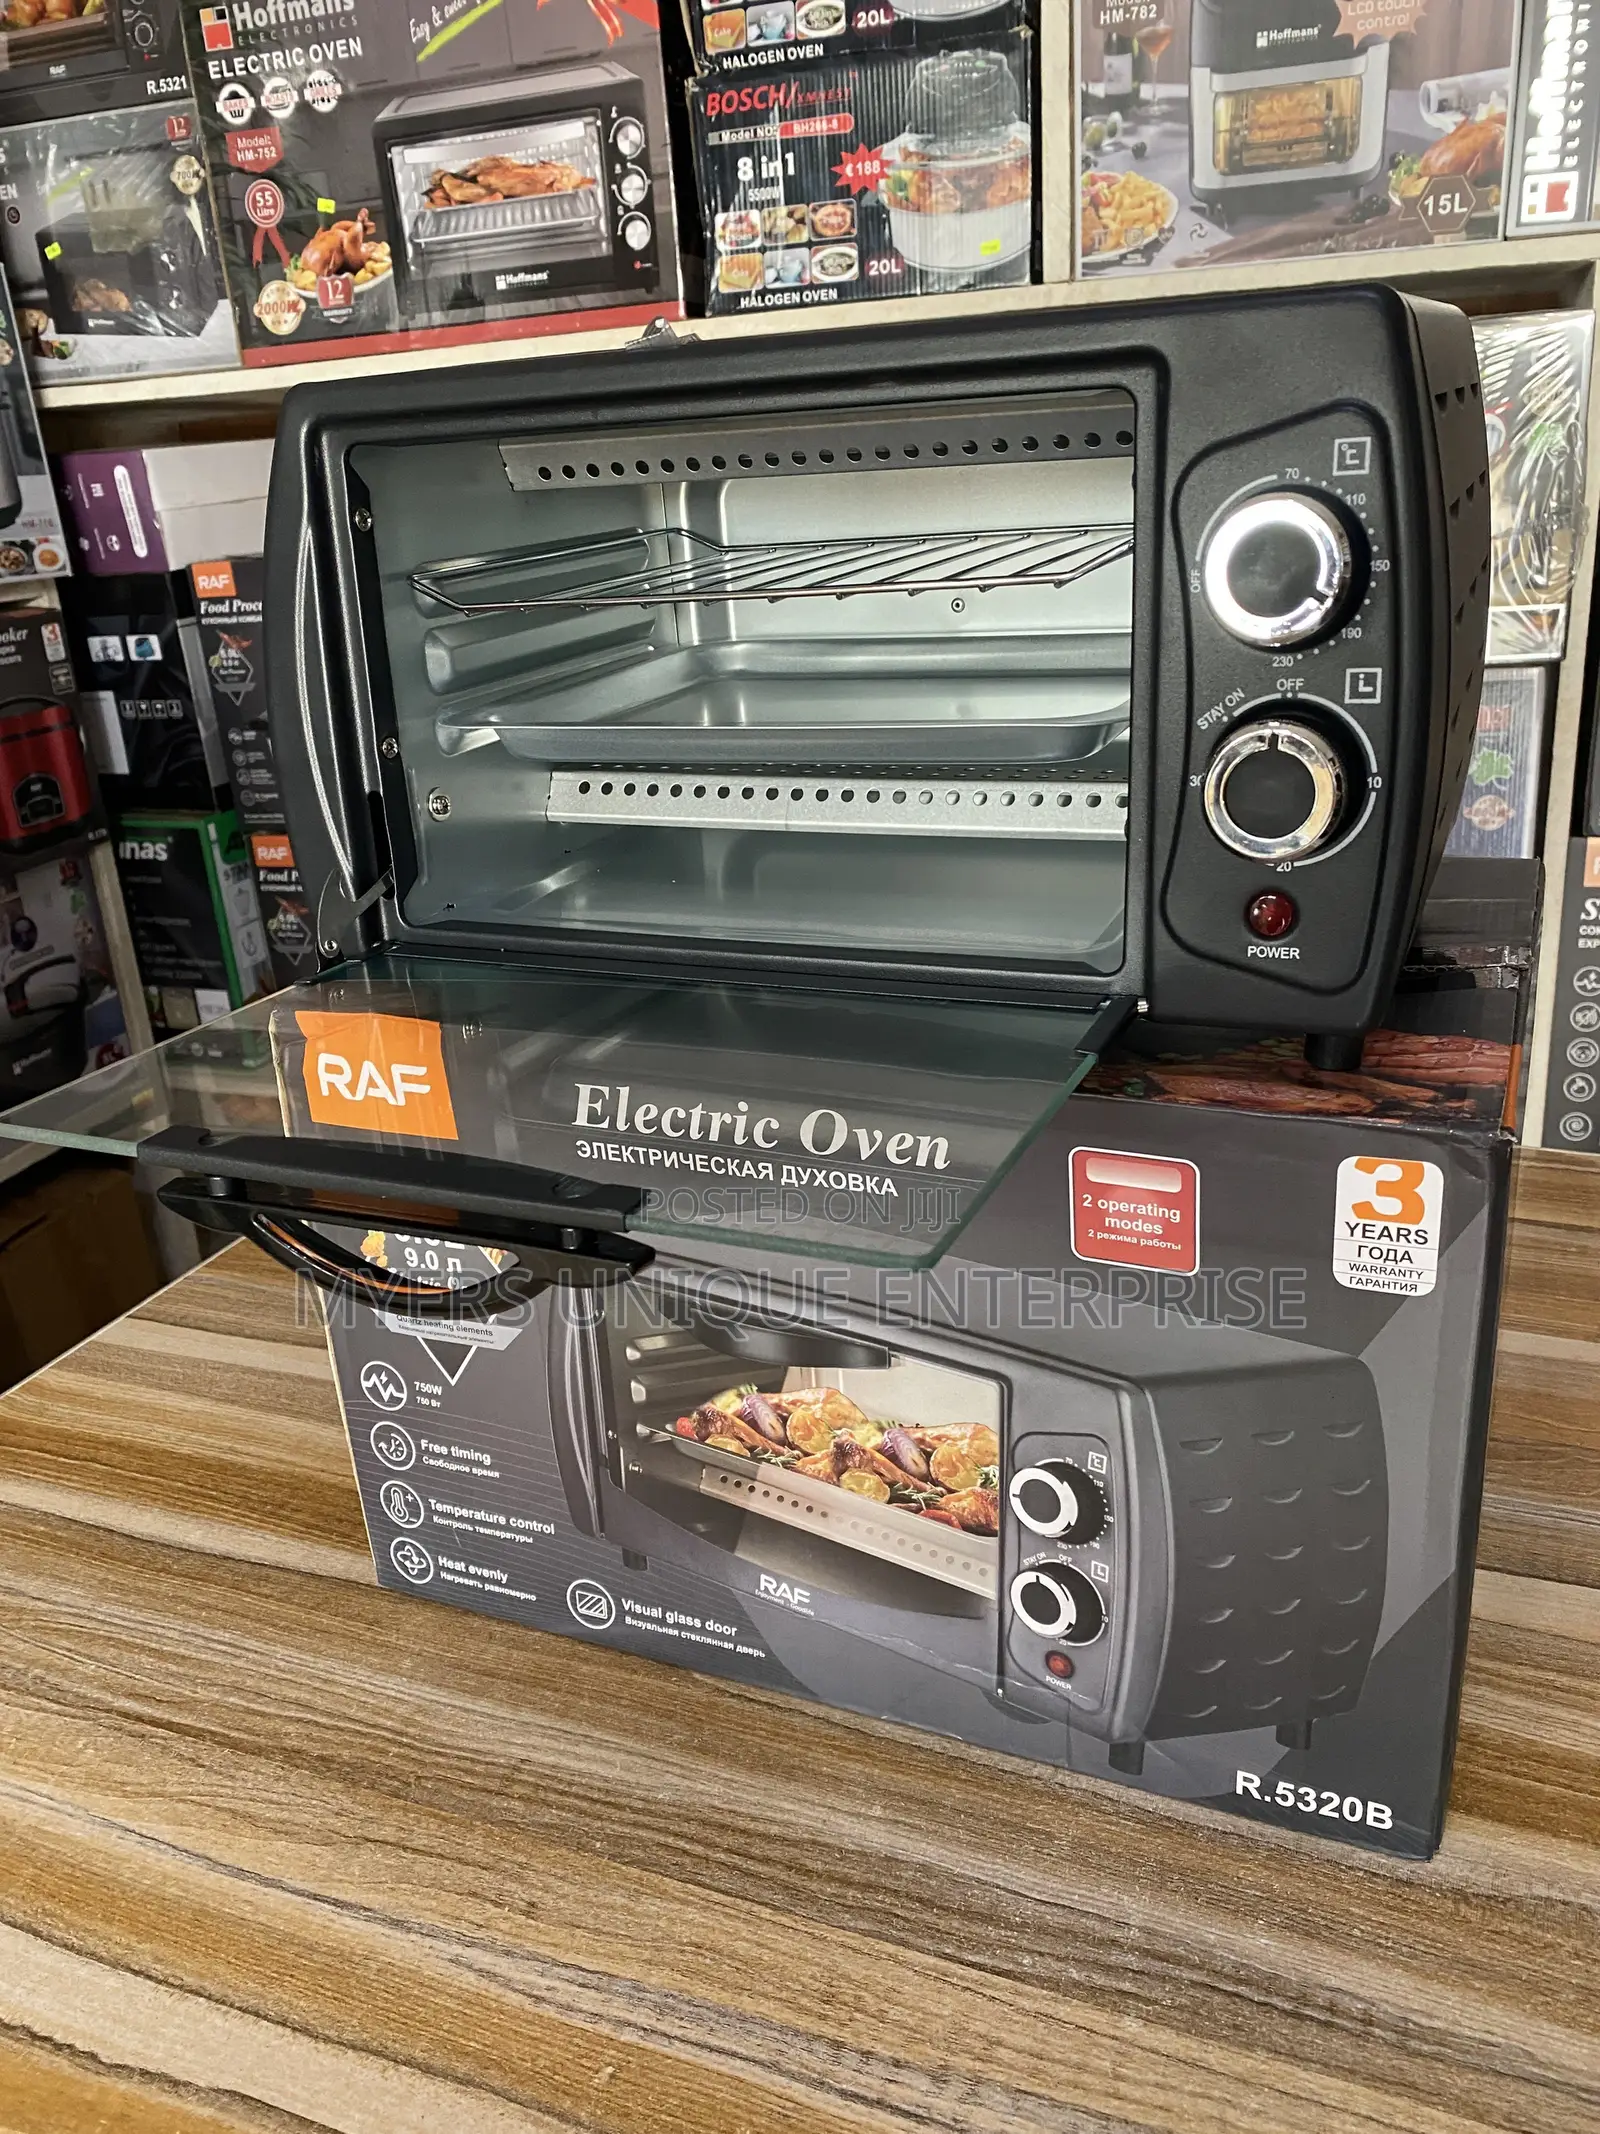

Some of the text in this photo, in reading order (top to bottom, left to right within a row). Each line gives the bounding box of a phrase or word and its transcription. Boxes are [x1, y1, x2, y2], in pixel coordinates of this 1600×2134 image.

[232, 0, 355, 31] Hoffmans
[856, 6, 890, 28] 20L
[1100, 4, 1157, 25] HM-782
[1356, 13, 1410, 30] control
[238, 15, 358, 46] ELECTRONICS
[409, 18, 431, 44] Easy
[1269, 27, 1319, 41] Hoffmans
[208, 36, 363, 79] ELECTRIC OVEN
[723, 43, 824, 70] HALOGEN OVEN
[147, 75, 187, 95] R.5321
[236, 135, 272, 149] Model:
[722, 128, 754, 142] Model
[236, 147, 277, 162] HM-752
[737, 151, 795, 182] 8 in 1
[255, 190, 273, 207] 55
[1422, 192, 1468, 217] 15L
[256, 206, 275, 218] Litre
[868, 258, 901, 276] 20L
[326, 280, 345, 300] 12
[740, 288, 838, 309] HALOGEN OVEN
[1285, 468, 1300, 480] 70
[1345, 493, 1367, 506] 110
[1370, 560, 1391, 572] 150
[198, 574, 230, 590] RAF
[1190, 569, 1202, 594] OFF
[200, 600, 230, 615] Food
[1341, 627, 1362, 640] 190
[1272, 656, 1294, 668] 230
[1276, 678, 1304, 691] OFF
[1196, 687, 1246, 731] STAY ON
[1367, 776, 1382, 789] 10
[257, 846, 288, 862] RAF
[258, 869, 288, 883] Food
[1276, 863, 1292, 872] 20
[1247, 946, 1300, 960] POWER
[316, 1052, 432, 1107] RAF
[572, 1083, 952, 1170] Electric Oven
[576, 1139, 900, 1198] ЭЛЕКТРИЧЕСКАЯ ДУХОВКА
[1351, 1157, 1426, 1226] 3
[1082, 1194, 1181, 1223] 2 operating
[1105, 1217, 1164, 1235] modes
[1345, 1221, 1429, 1245] YEARS
[1088, 1229, 1182, 1251] 2 режима работы
[404, 1247, 463, 1274] 9.0 л
[1357, 1244, 1414, 1265] ГОДА
[1348, 1262, 1425, 1280] WARRANTY
[1349, 1276, 1418, 1293] ГАРАНТИЯ
[396, 1314, 494, 1337] Quartz heating elements
[414, 1381, 443, 1396] 750W
[416, 1397, 430, 1407] 750
[420, 1438, 492, 1466] Free timing
[422, 1456, 500, 1481] Свободное время
[428, 1498, 555, 1535] Temperature control
[432, 1515, 533, 1544] Контроль температуры
[1058, 1553, 1072, 1563] OFF
[437, 1555, 509, 1584] Heat evenly
[440, 1571, 537, 1602] Нагревать равномерно
[760, 1573, 811, 1604] RAF
[621, 1598, 738, 1637] Visual glass door
[625, 1616, 766, 1659] Визуальная стеклянная дверь
[1045, 1675, 1072, 1691] POWER
[1235, 1769, 1394, 1830] R.5320B
